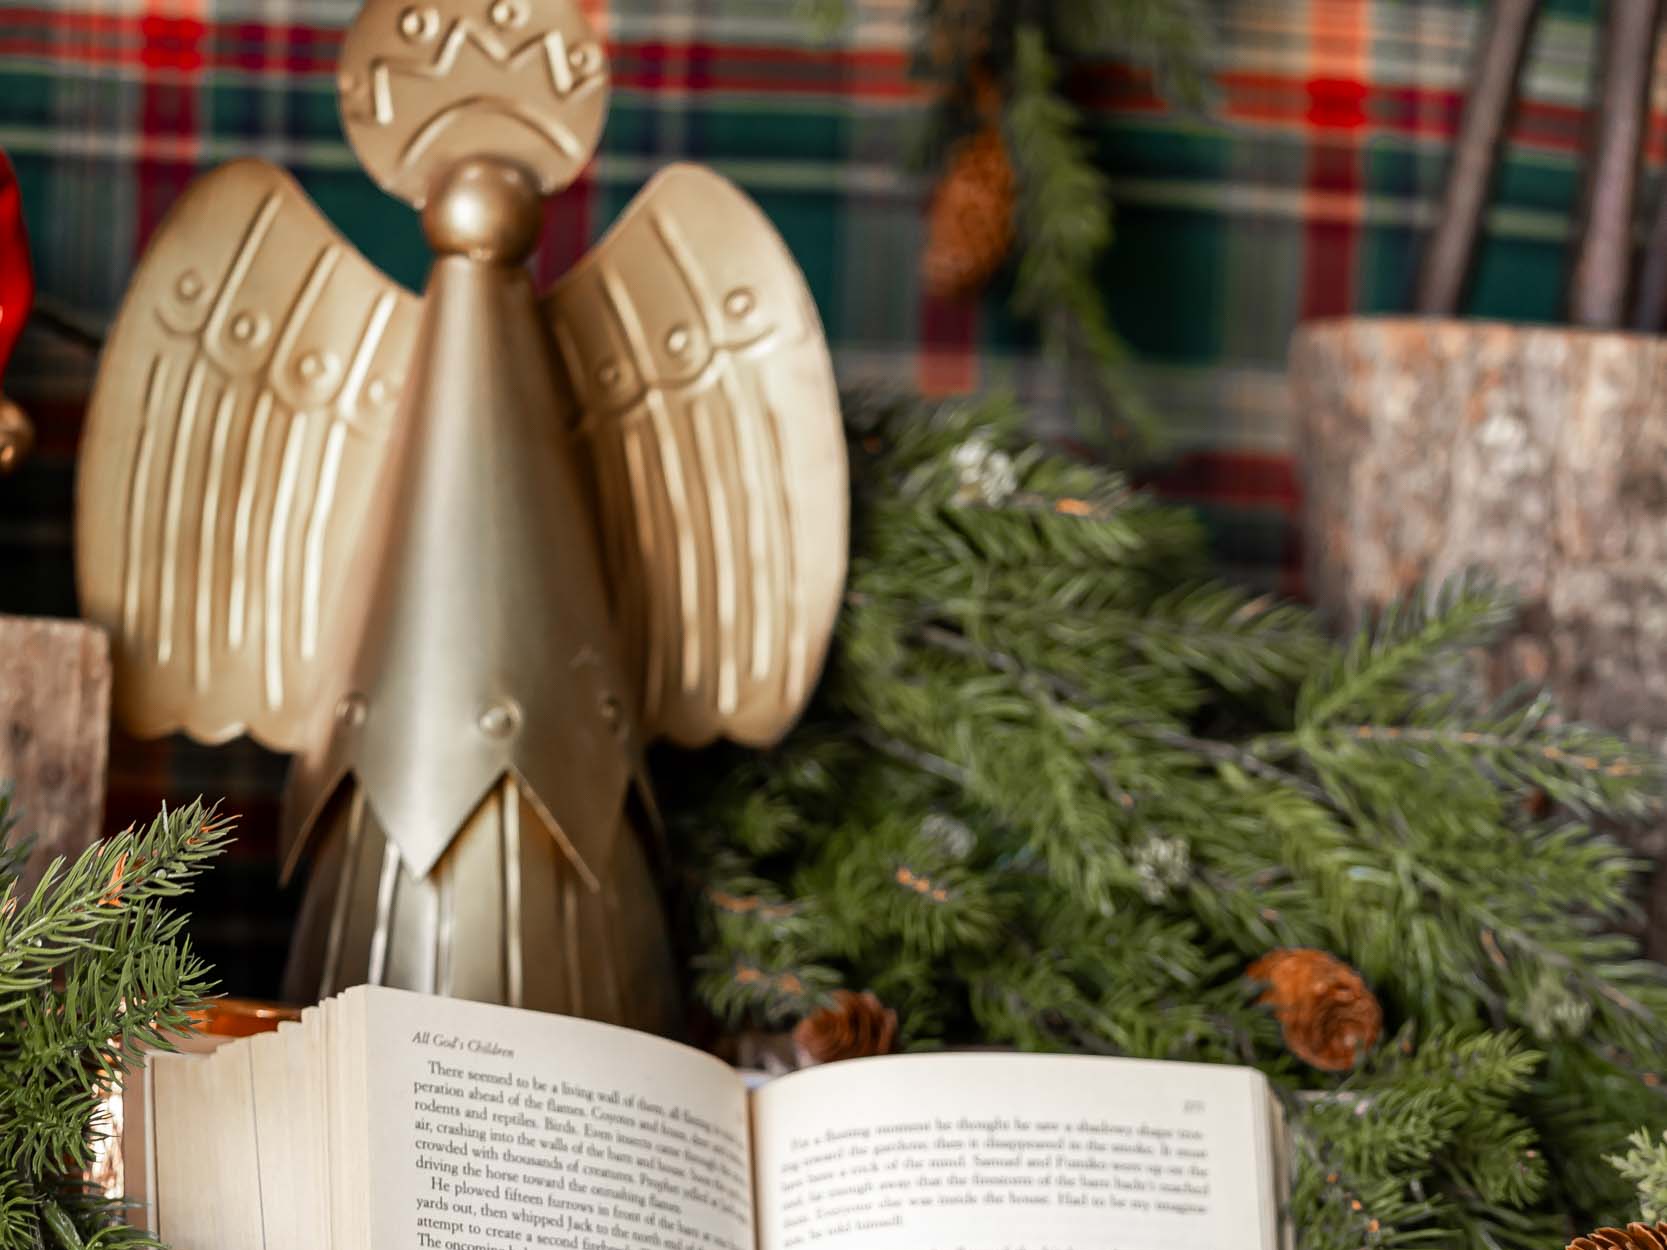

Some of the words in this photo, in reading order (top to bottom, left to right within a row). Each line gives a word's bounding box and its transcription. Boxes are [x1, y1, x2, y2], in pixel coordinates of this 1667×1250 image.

[431, 1176, 450, 1192] He
[454, 1180, 500, 1199] plowed
[504, 1186, 544, 1206] fifteen
[416, 1196, 449, 1211] yards
[451, 1203, 476, 1216] out,
[480, 1202, 508, 1219] then
[511, 1208, 564, 1228] whipped
